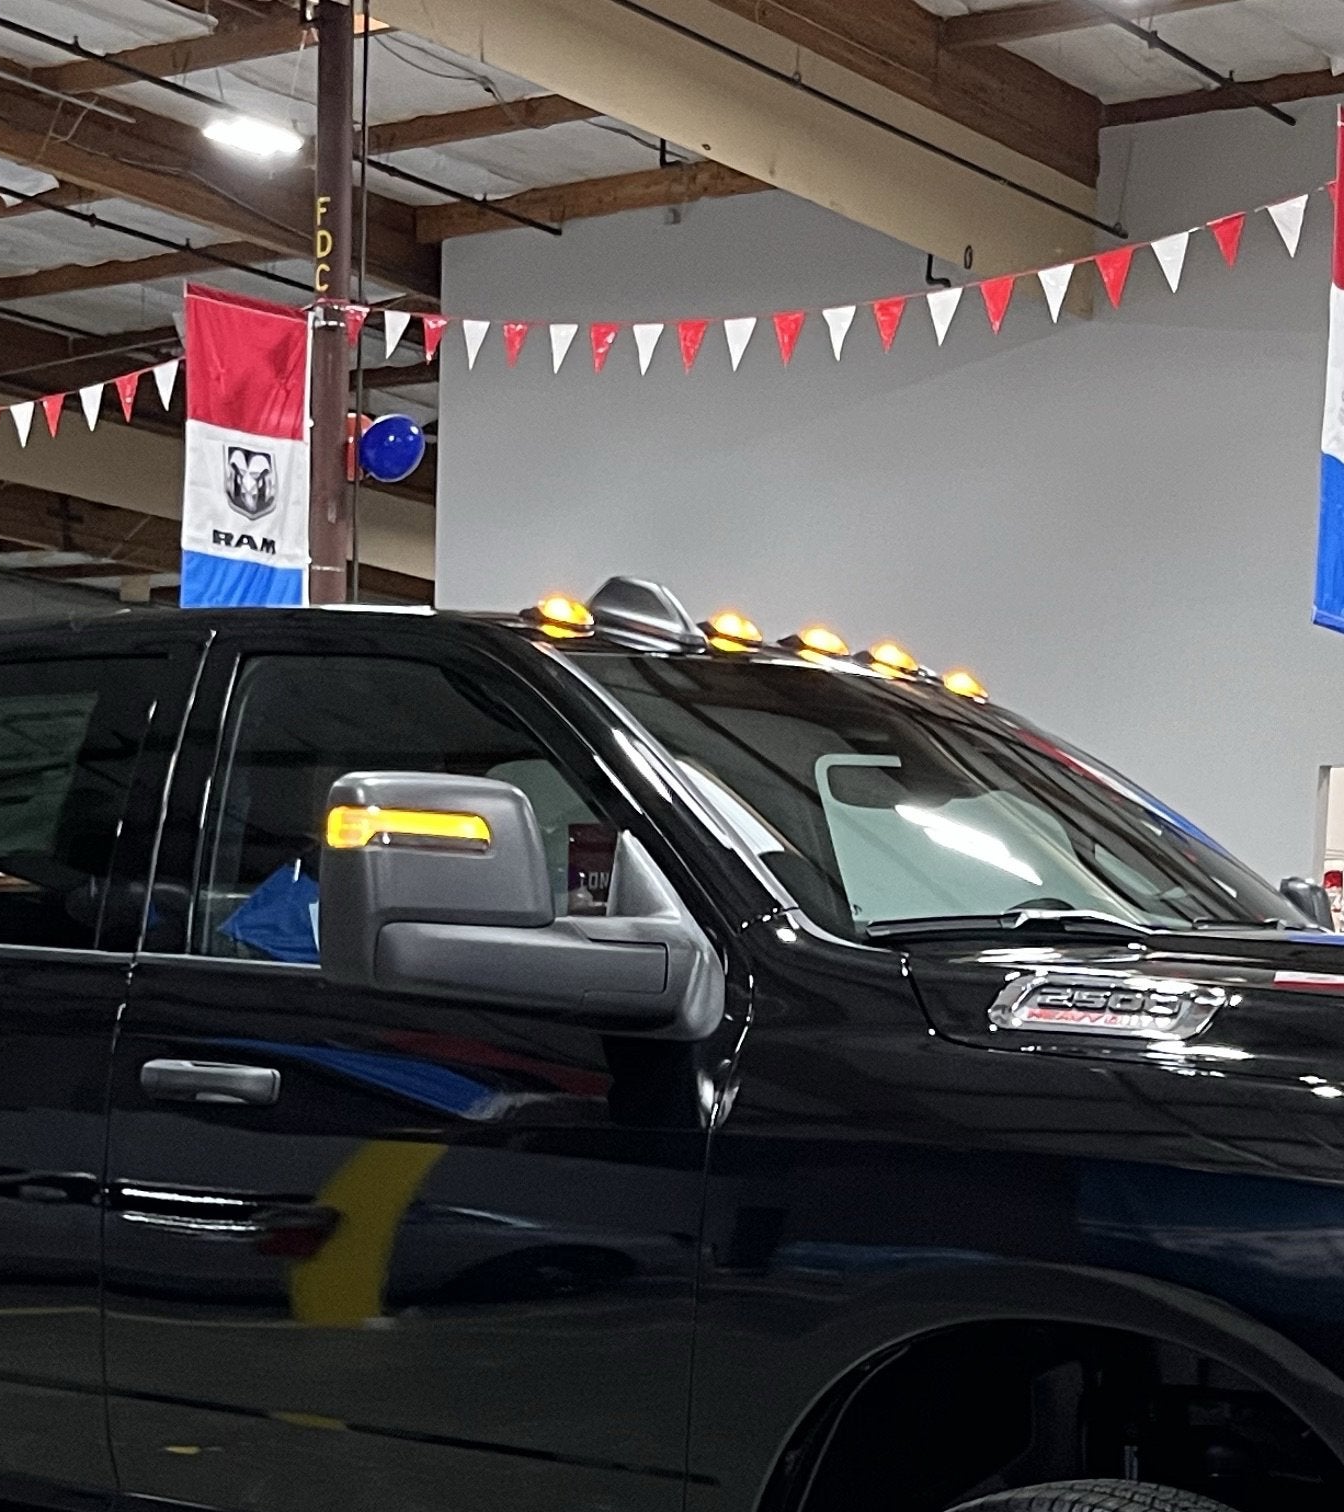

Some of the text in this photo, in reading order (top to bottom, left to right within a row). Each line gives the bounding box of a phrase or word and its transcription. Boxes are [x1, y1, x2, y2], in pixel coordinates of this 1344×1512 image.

[316, 196, 333, 292] FDC
[212, 528, 276, 555] RAM
[1037, 987, 1182, 1017] 2500
